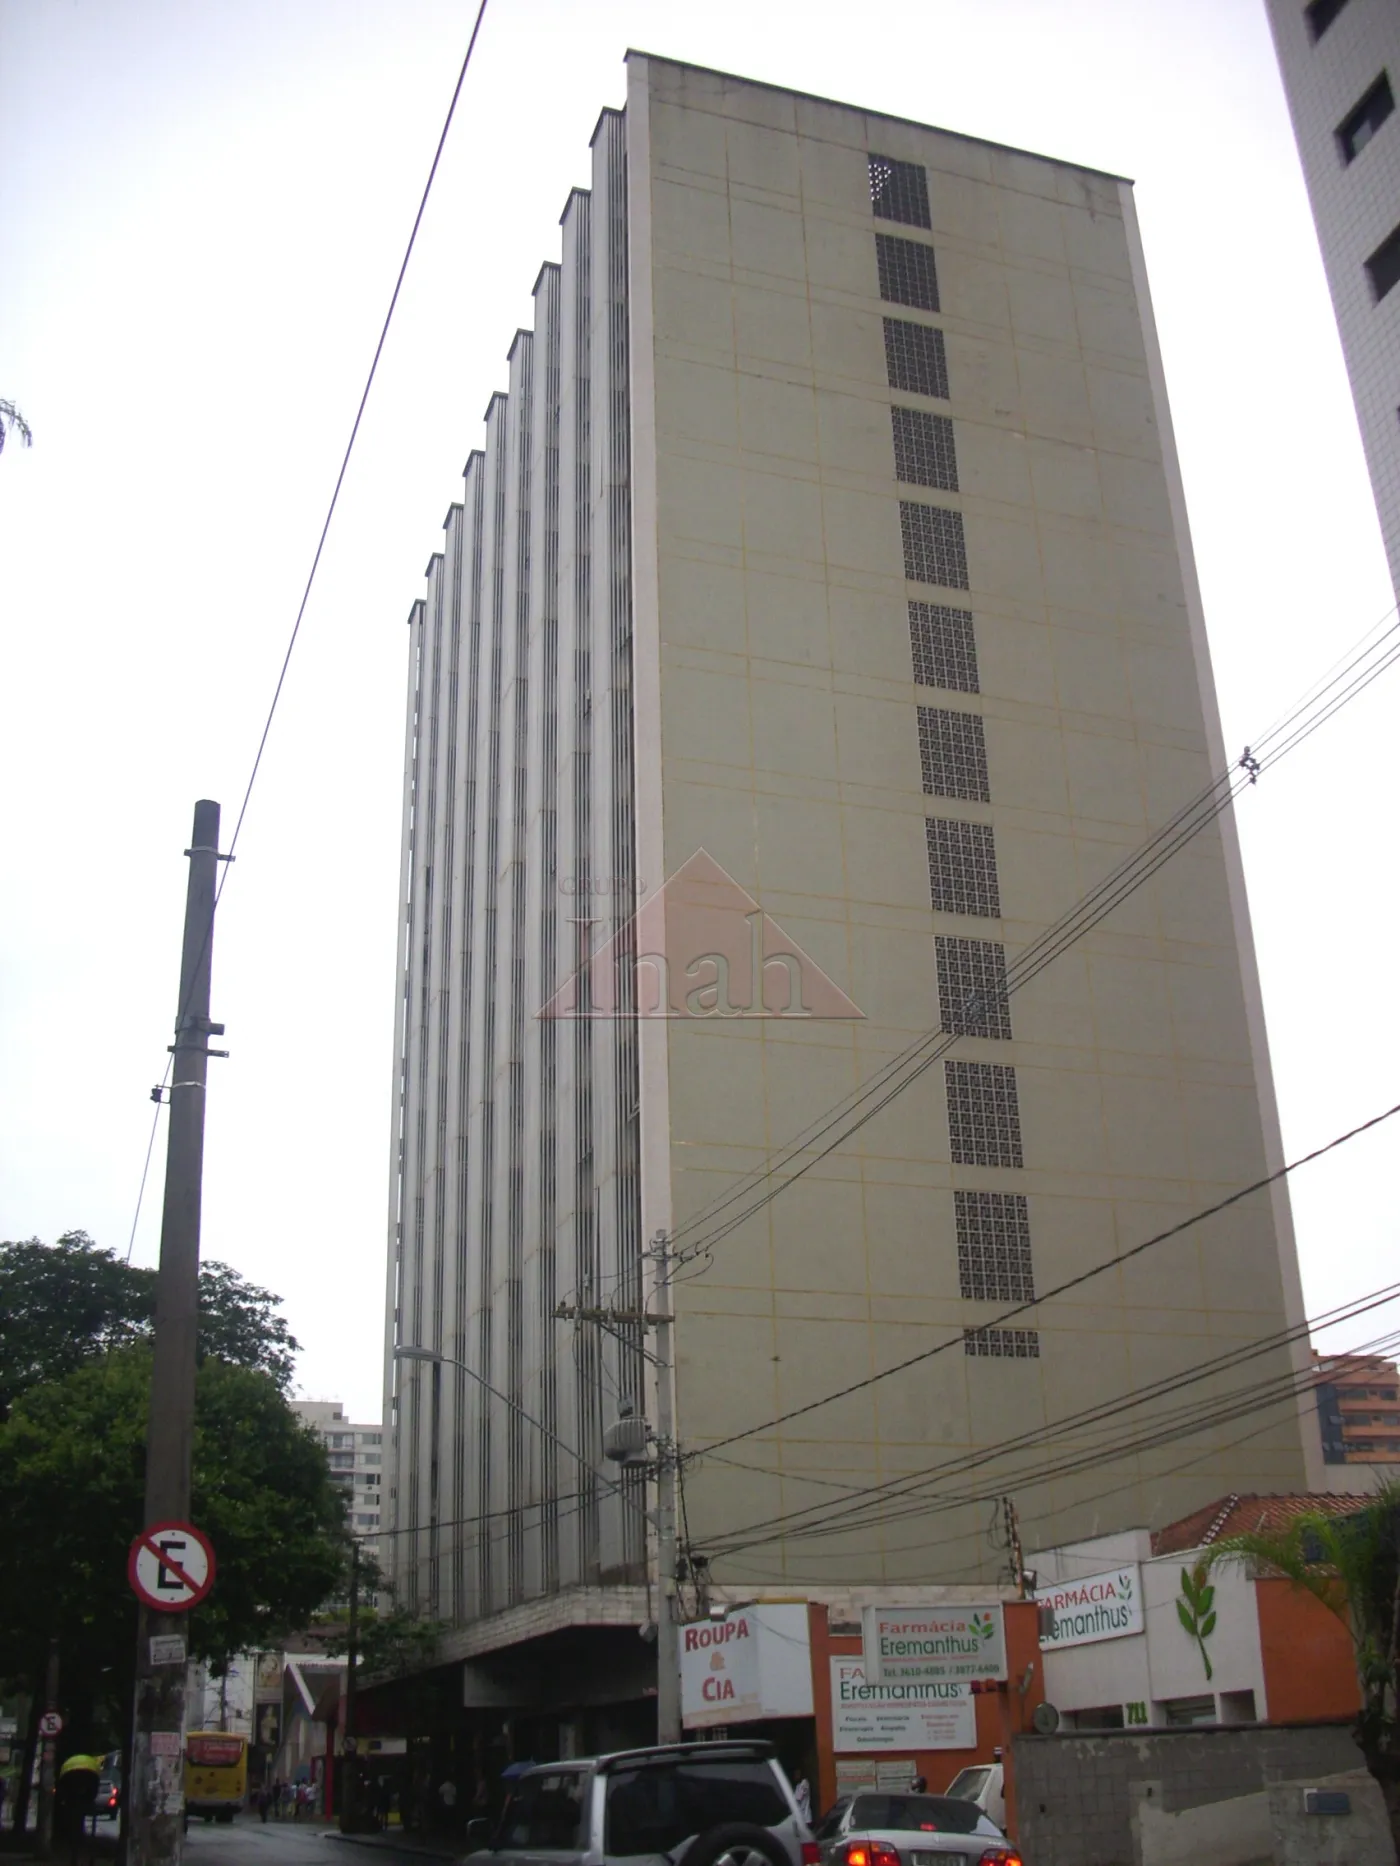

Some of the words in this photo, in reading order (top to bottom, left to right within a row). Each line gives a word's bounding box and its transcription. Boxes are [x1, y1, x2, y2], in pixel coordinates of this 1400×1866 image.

[157, 1540, 186, 1589] E
[685, 1616, 750, 1652] ROUPA
[879, 1620, 966, 1634] Farmácia
[1038, 1604, 1128, 1642] emanthus
[880, 1636, 979, 1655] Eremanthus
[702, 1676, 735, 1701] CIA
[840, 1681, 959, 1700] Eremanthus
[1125, 1701, 1148, 1725] 711
